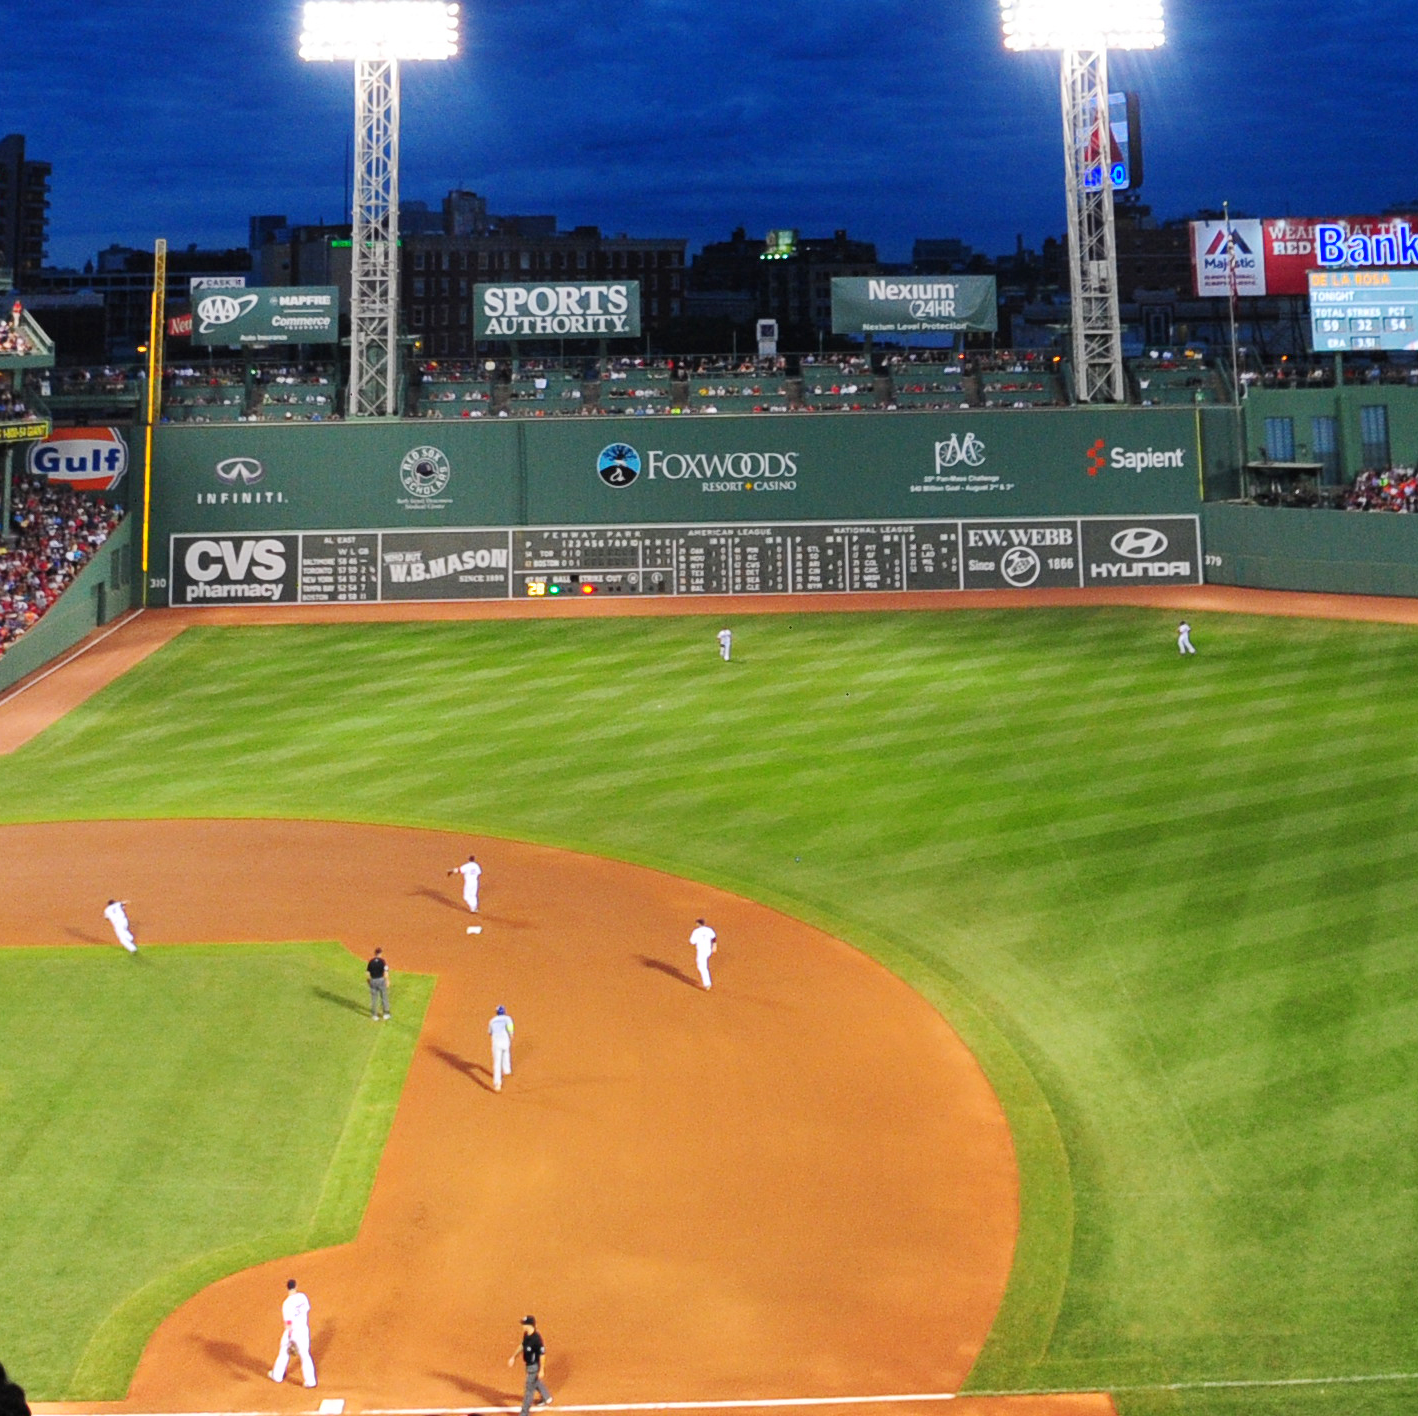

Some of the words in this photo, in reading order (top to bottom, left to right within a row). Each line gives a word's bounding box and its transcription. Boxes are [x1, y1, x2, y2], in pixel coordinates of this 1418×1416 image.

[1273, 242, 1311, 255] RED
[1312, 275, 1327, 285] DE
[1333, 274, 1350, 285] LA
[1355, 274, 1391, 285] ROSA
[869, 280, 954, 300] Nexium
[279, 296, 330, 305] MAPFRE
[484, 285, 628, 316] SPORTS
[1312, 291, 1355, 302] TONIGHT
[200, 296, 238, 323] AAA
[1315, 308, 1344, 318] TOTAL
[1347, 308, 1381, 318] STRIKES
[1388, 307, 1405, 317] PCT
[272, 315, 330, 327] Commerce
[485, 315, 628, 334] AUTHORITY
[863, 323, 895, 331] Nexium
[897, 322, 919, 331] Level
[922, 322, 967, 330] Protection
[1323, 320, 1339, 332] 59
[1357, 320, 1372, 331] 32
[1391, 319, 1406, 331] 54
[1327, 339, 1346, 348] ERA
[34, 447, 120, 472] Gulf
[403, 451, 419, 470] RED
[422, 448, 441, 462] SOX
[647, 450, 797, 479] FOXWOODS
[1110, 447, 1183, 473] Sapient
[404, 467, 447, 494] SCHOLARS
[702, 482, 743, 492] RESORT
[753, 480, 797, 491] CASINO
[197, 492, 283, 504] INFINITI
[606, 531, 641, 539] PARK
[737, 528, 772, 536] LEAGUE
[833, 526, 877, 534] NATIONAL
[324, 536, 334, 544] AL
[337, 536, 355, 544] EAST
[1007, 528, 1073, 546] WEBB
[185, 539, 286, 581] CVS
[302, 558, 335, 566] BALTIMORE
[968, 559, 995, 571] Since
[1048, 558, 1074, 570] 1866
[1205, 555, 1222, 566] 379
[1091, 561, 1191, 577] HYUNDAI
[150, 579, 166, 588] 310
[317, 575, 334, 583] YORK
[553, 575, 571, 583] BALL
[186, 582, 283, 602] pharmacy
[323, 584, 335, 592] BAY
[527, 582, 545, 596] 28
